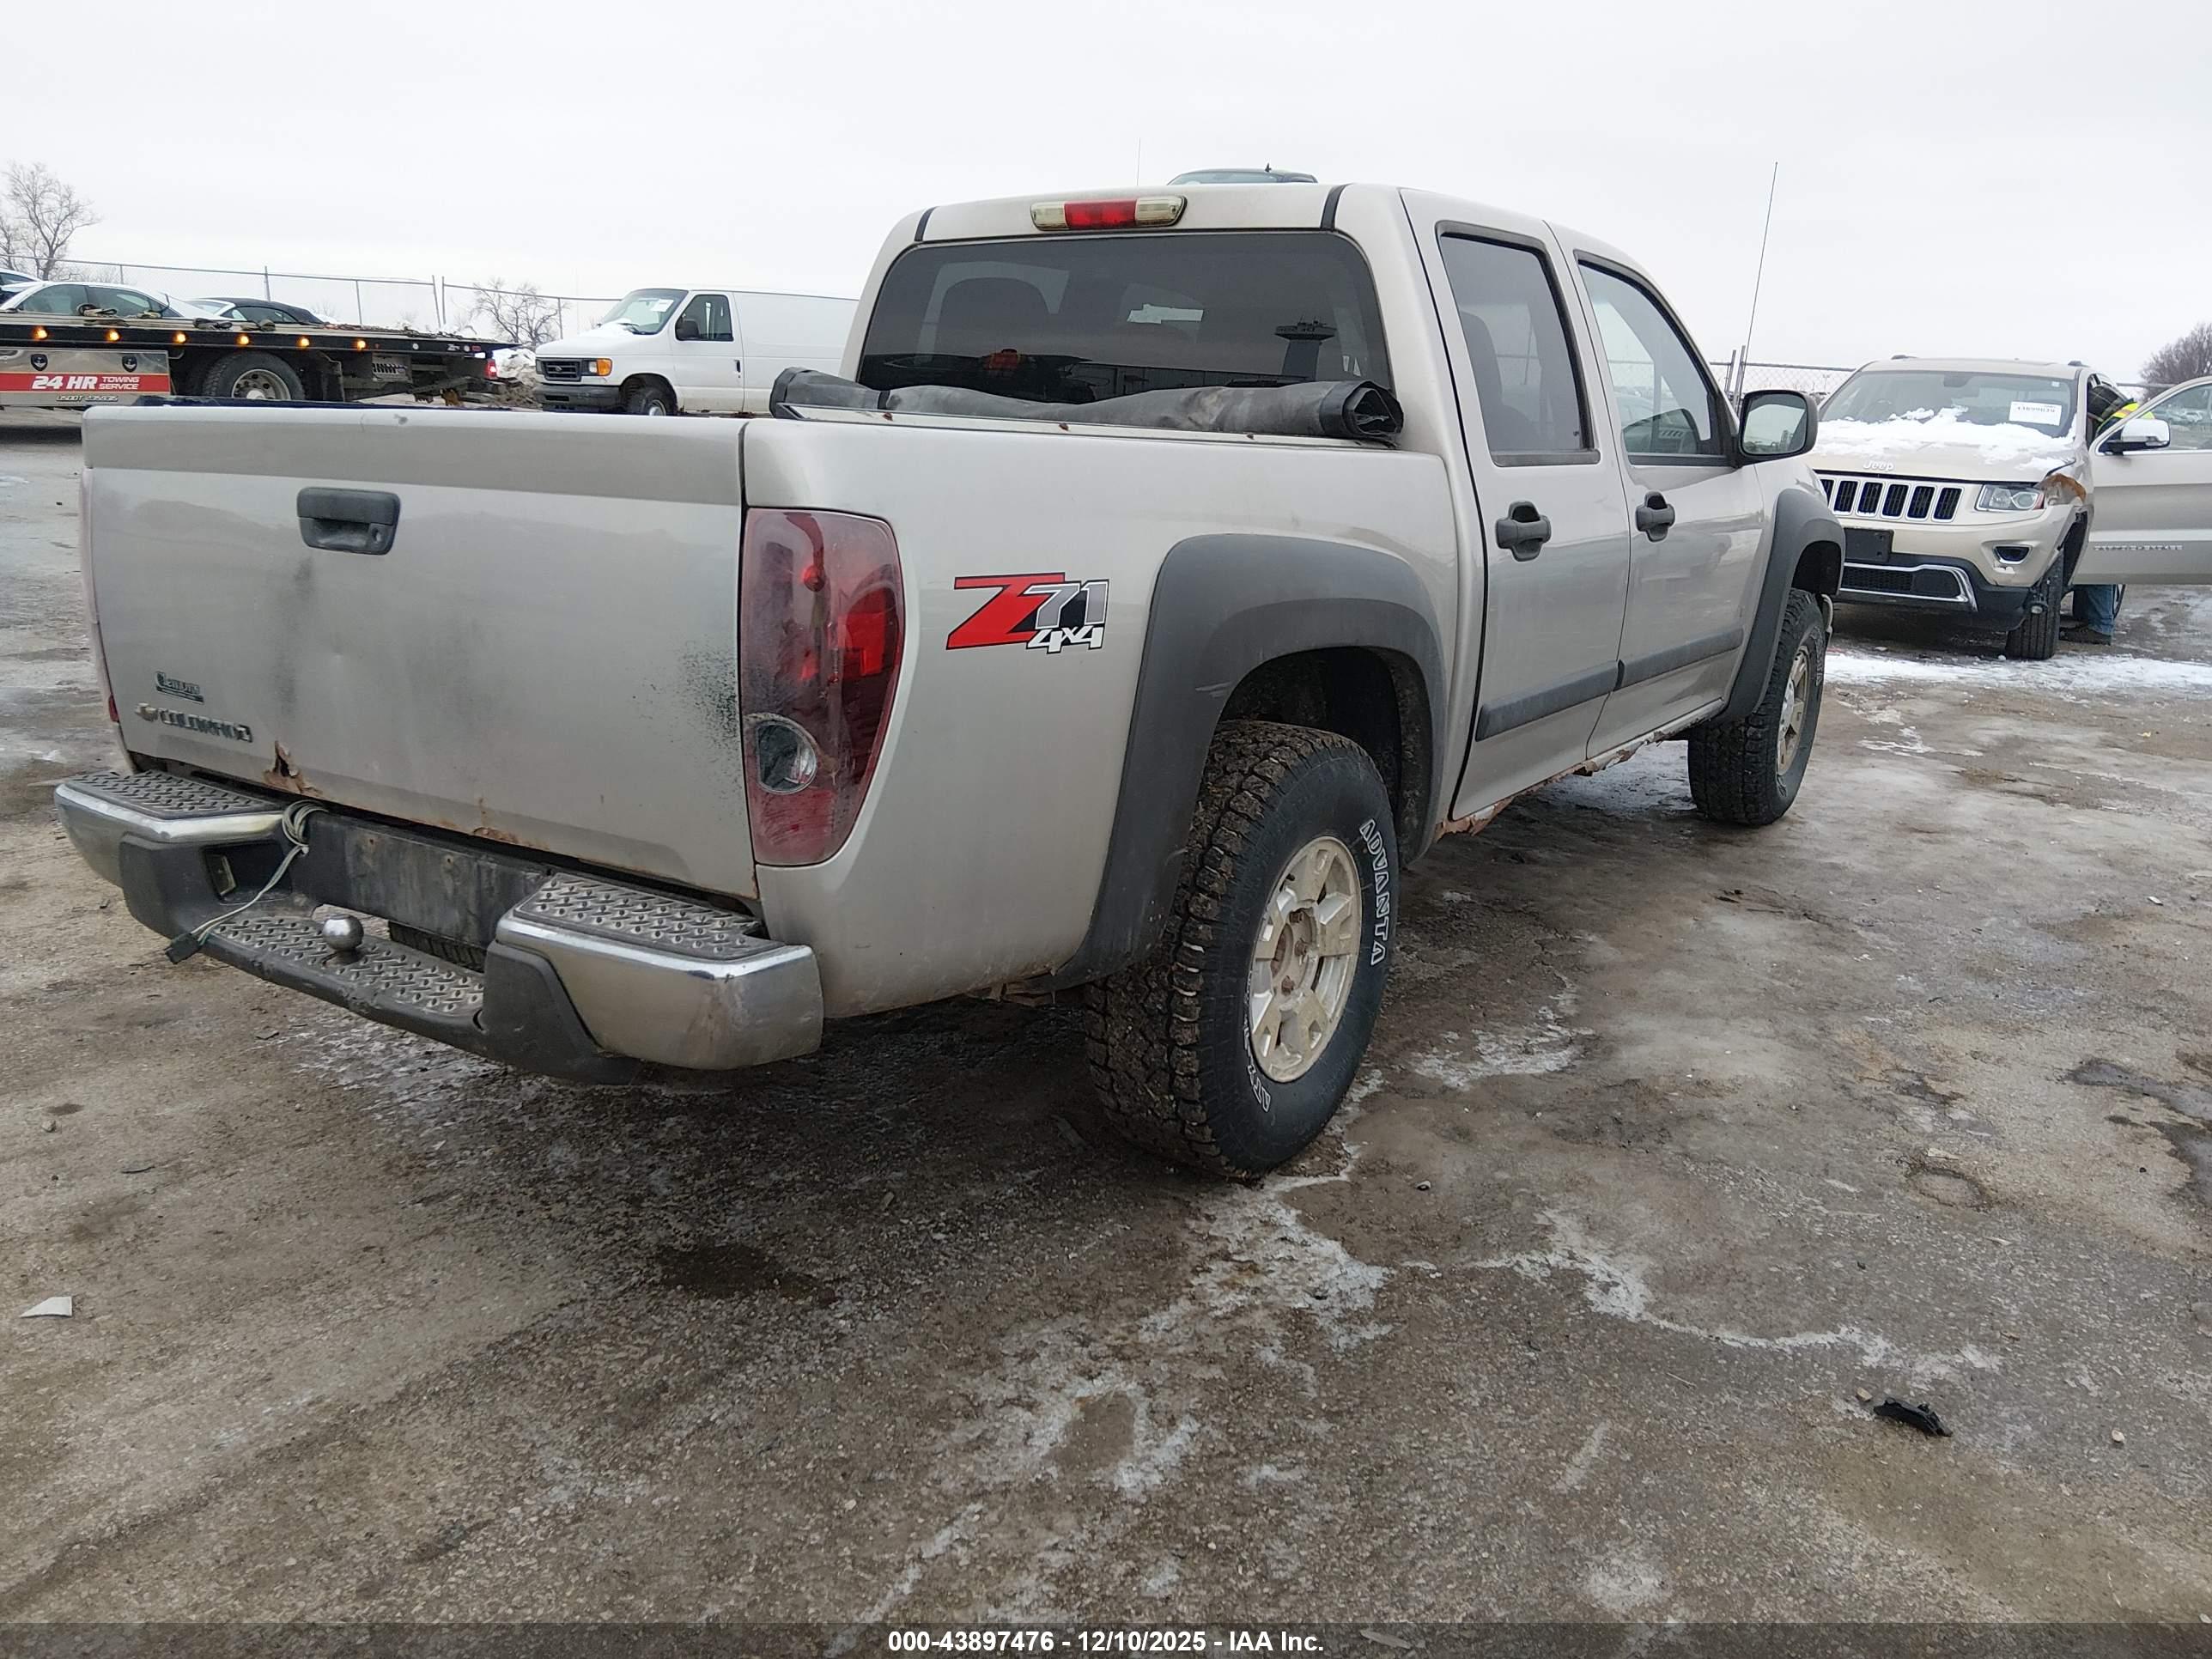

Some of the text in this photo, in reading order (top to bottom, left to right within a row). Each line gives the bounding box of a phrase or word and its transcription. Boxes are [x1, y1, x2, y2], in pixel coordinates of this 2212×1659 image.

[32, 376, 99, 390] 24 HR
[1863, 460, 1894, 471] Jeep
[946, 572, 1109, 650] Z71
[1359, 818, 1389, 966] ADVANTA
